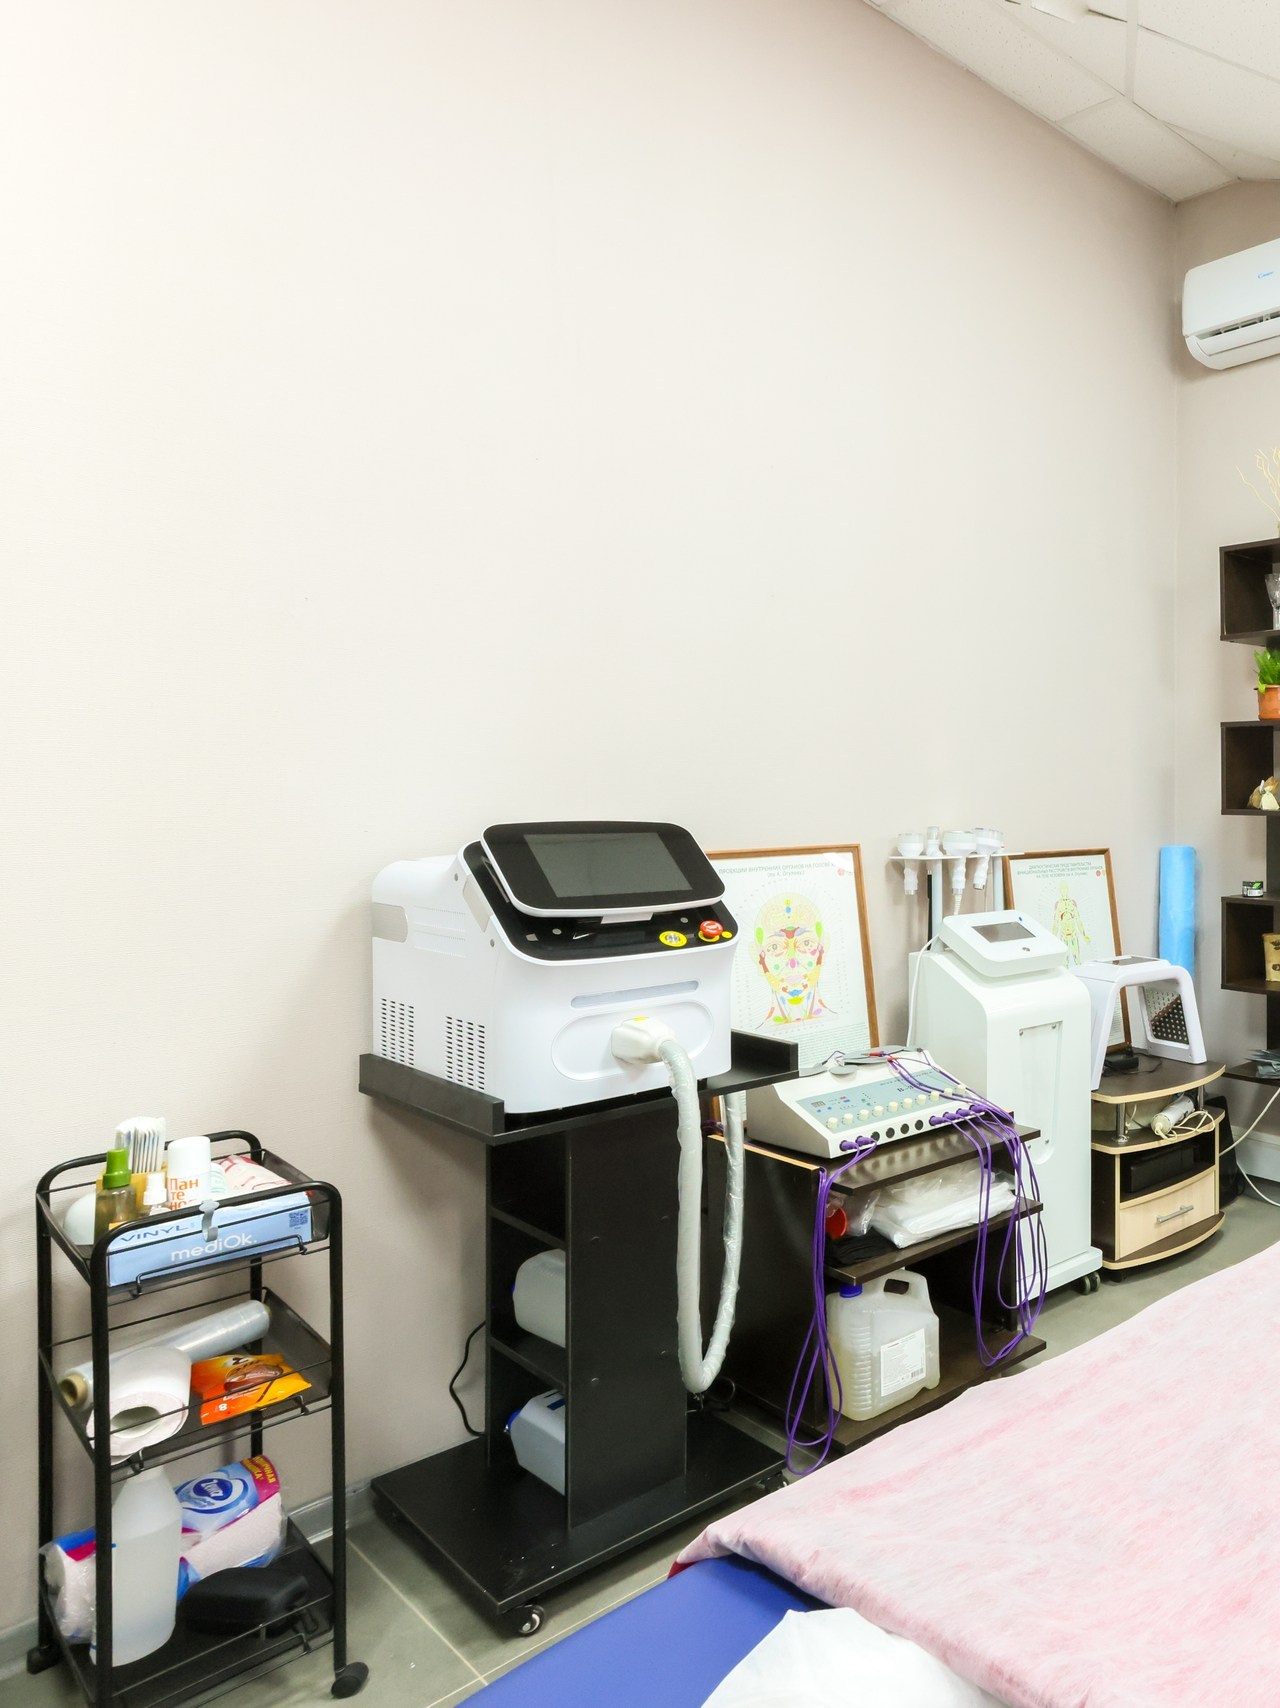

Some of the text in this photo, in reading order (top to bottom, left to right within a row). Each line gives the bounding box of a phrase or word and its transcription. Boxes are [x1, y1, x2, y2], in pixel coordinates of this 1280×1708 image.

[170, 1177, 199, 1191] Пан
[170, 1191, 185, 1201] те
[120, 1225, 189, 1242] VINYL
